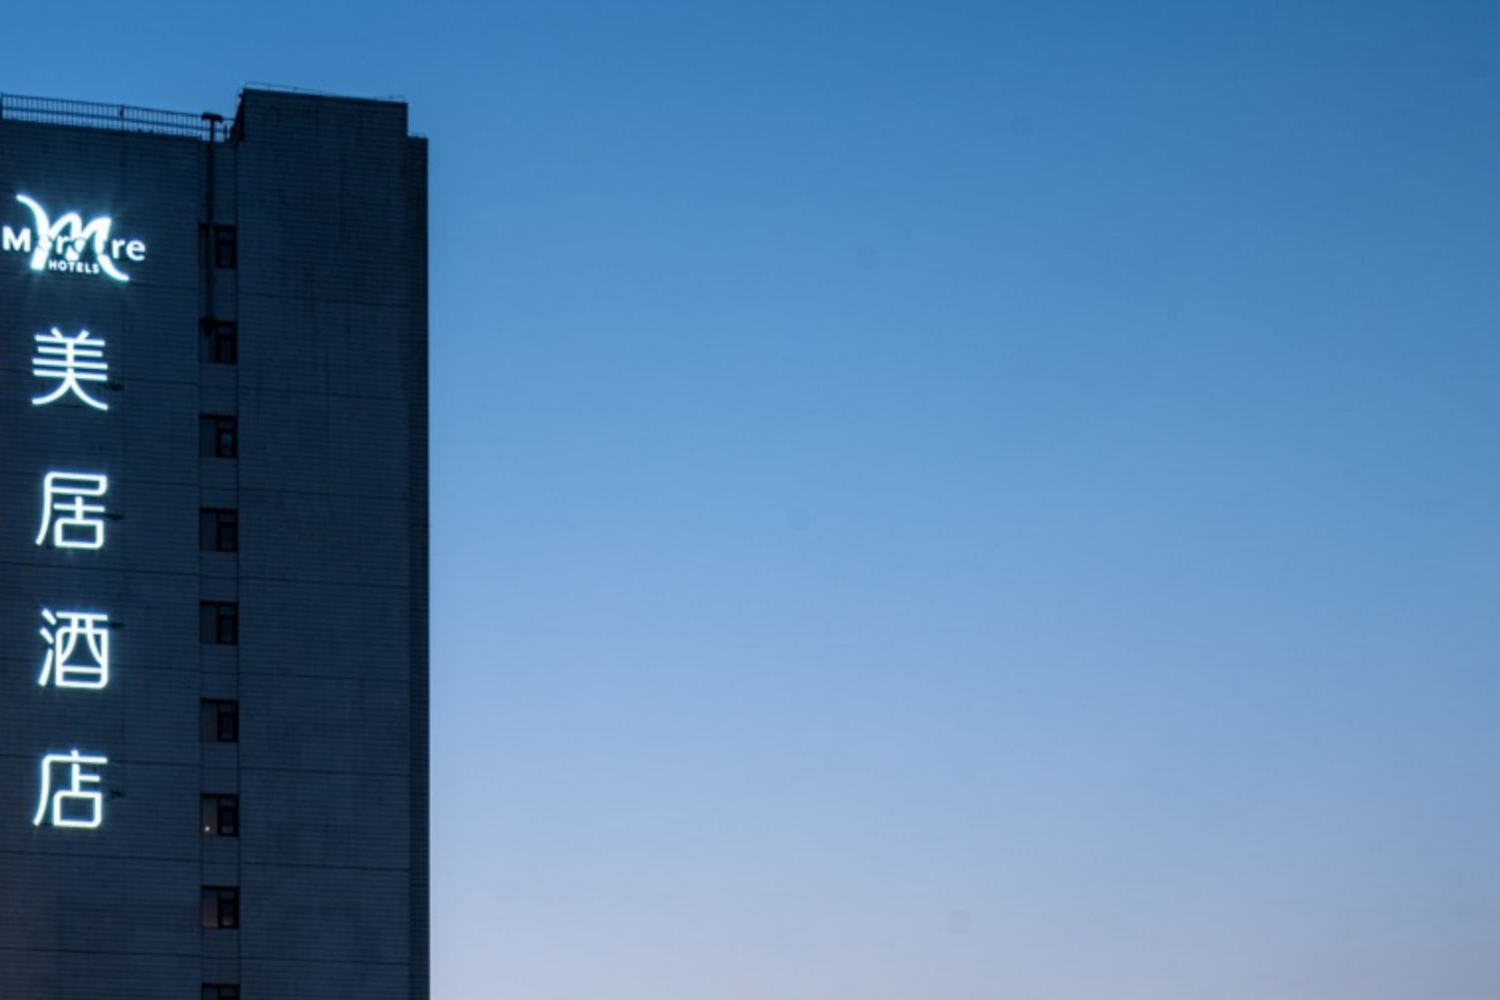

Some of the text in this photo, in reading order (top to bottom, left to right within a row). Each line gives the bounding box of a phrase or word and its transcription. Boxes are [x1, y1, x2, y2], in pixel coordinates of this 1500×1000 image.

[1, 225, 147, 262] Mrre
[48, 259, 100, 274] HOTELS
[31, 327, 110, 830] 美居酒店
